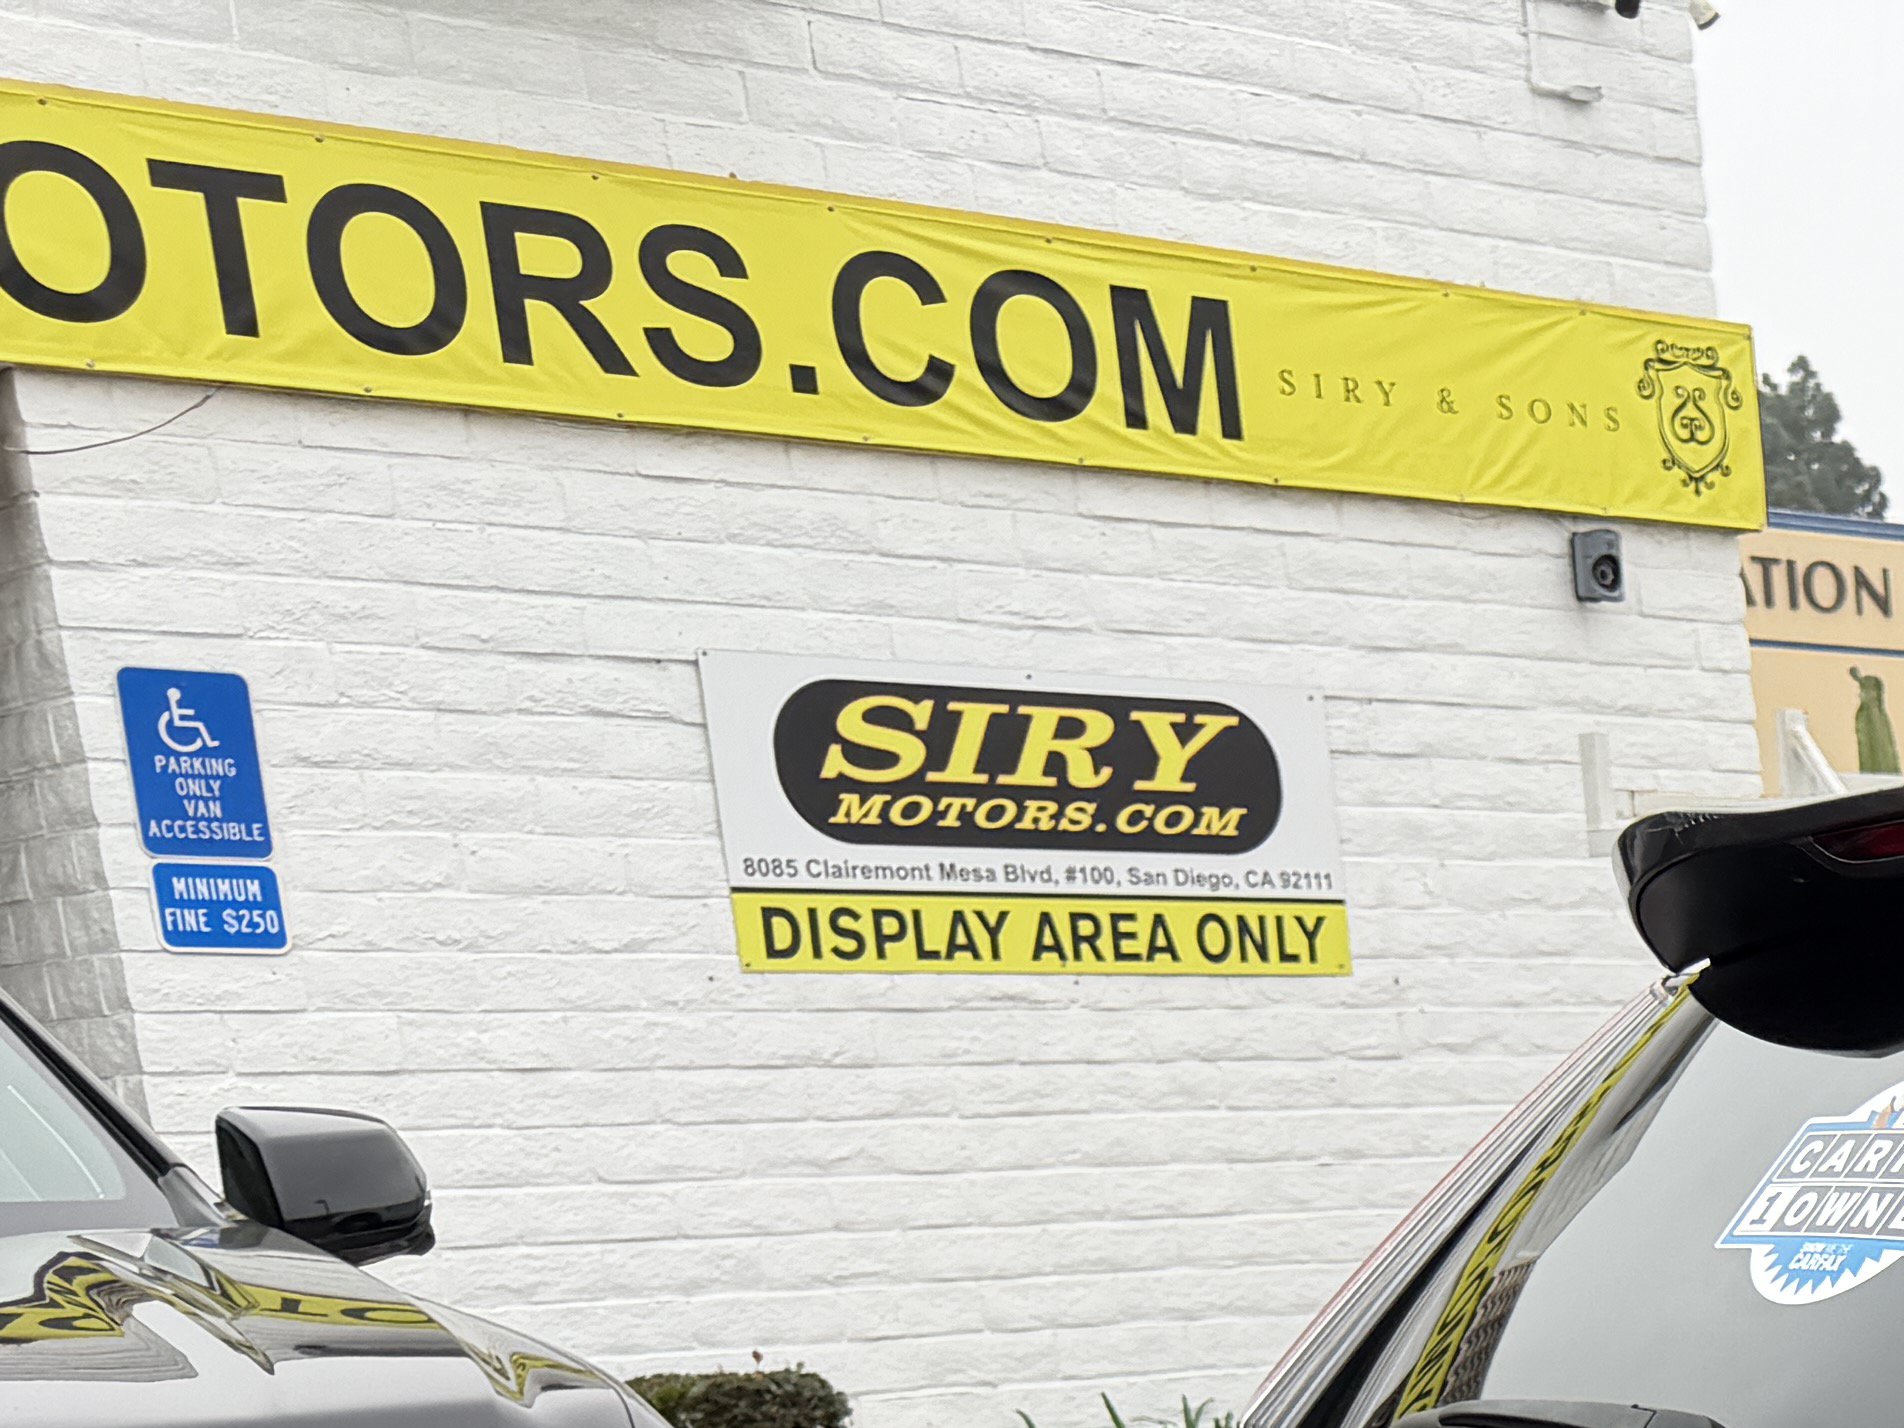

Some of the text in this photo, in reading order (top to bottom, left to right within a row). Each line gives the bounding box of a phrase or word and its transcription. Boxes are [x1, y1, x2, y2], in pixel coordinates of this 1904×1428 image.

[1278, 368, 1622, 433] SIRY & SONS
[819, 694, 1240, 793] SIRY
[154, 754, 237, 778] PARKING
[175, 777, 222, 798] ONLY
[183, 799, 222, 819] VAN
[828, 792, 1247, 838] MOTORS.COM
[148, 820, 265, 842] ACCESSIBLE
[743, 857, 799, 880] 8085
[805, 858, 933, 883] Clairemont
[939, 863, 998, 885] Mesa
[1128, 867, 1168, 889] San
[1244, 870, 1276, 891] CA
[1279, 871, 1334, 892] 92111
[172, 877, 263, 902] MINIMUM
[165, 907, 280, 934] FINE $250
[759, 905, 1327, 965] DISPLAY AREA ONLY
